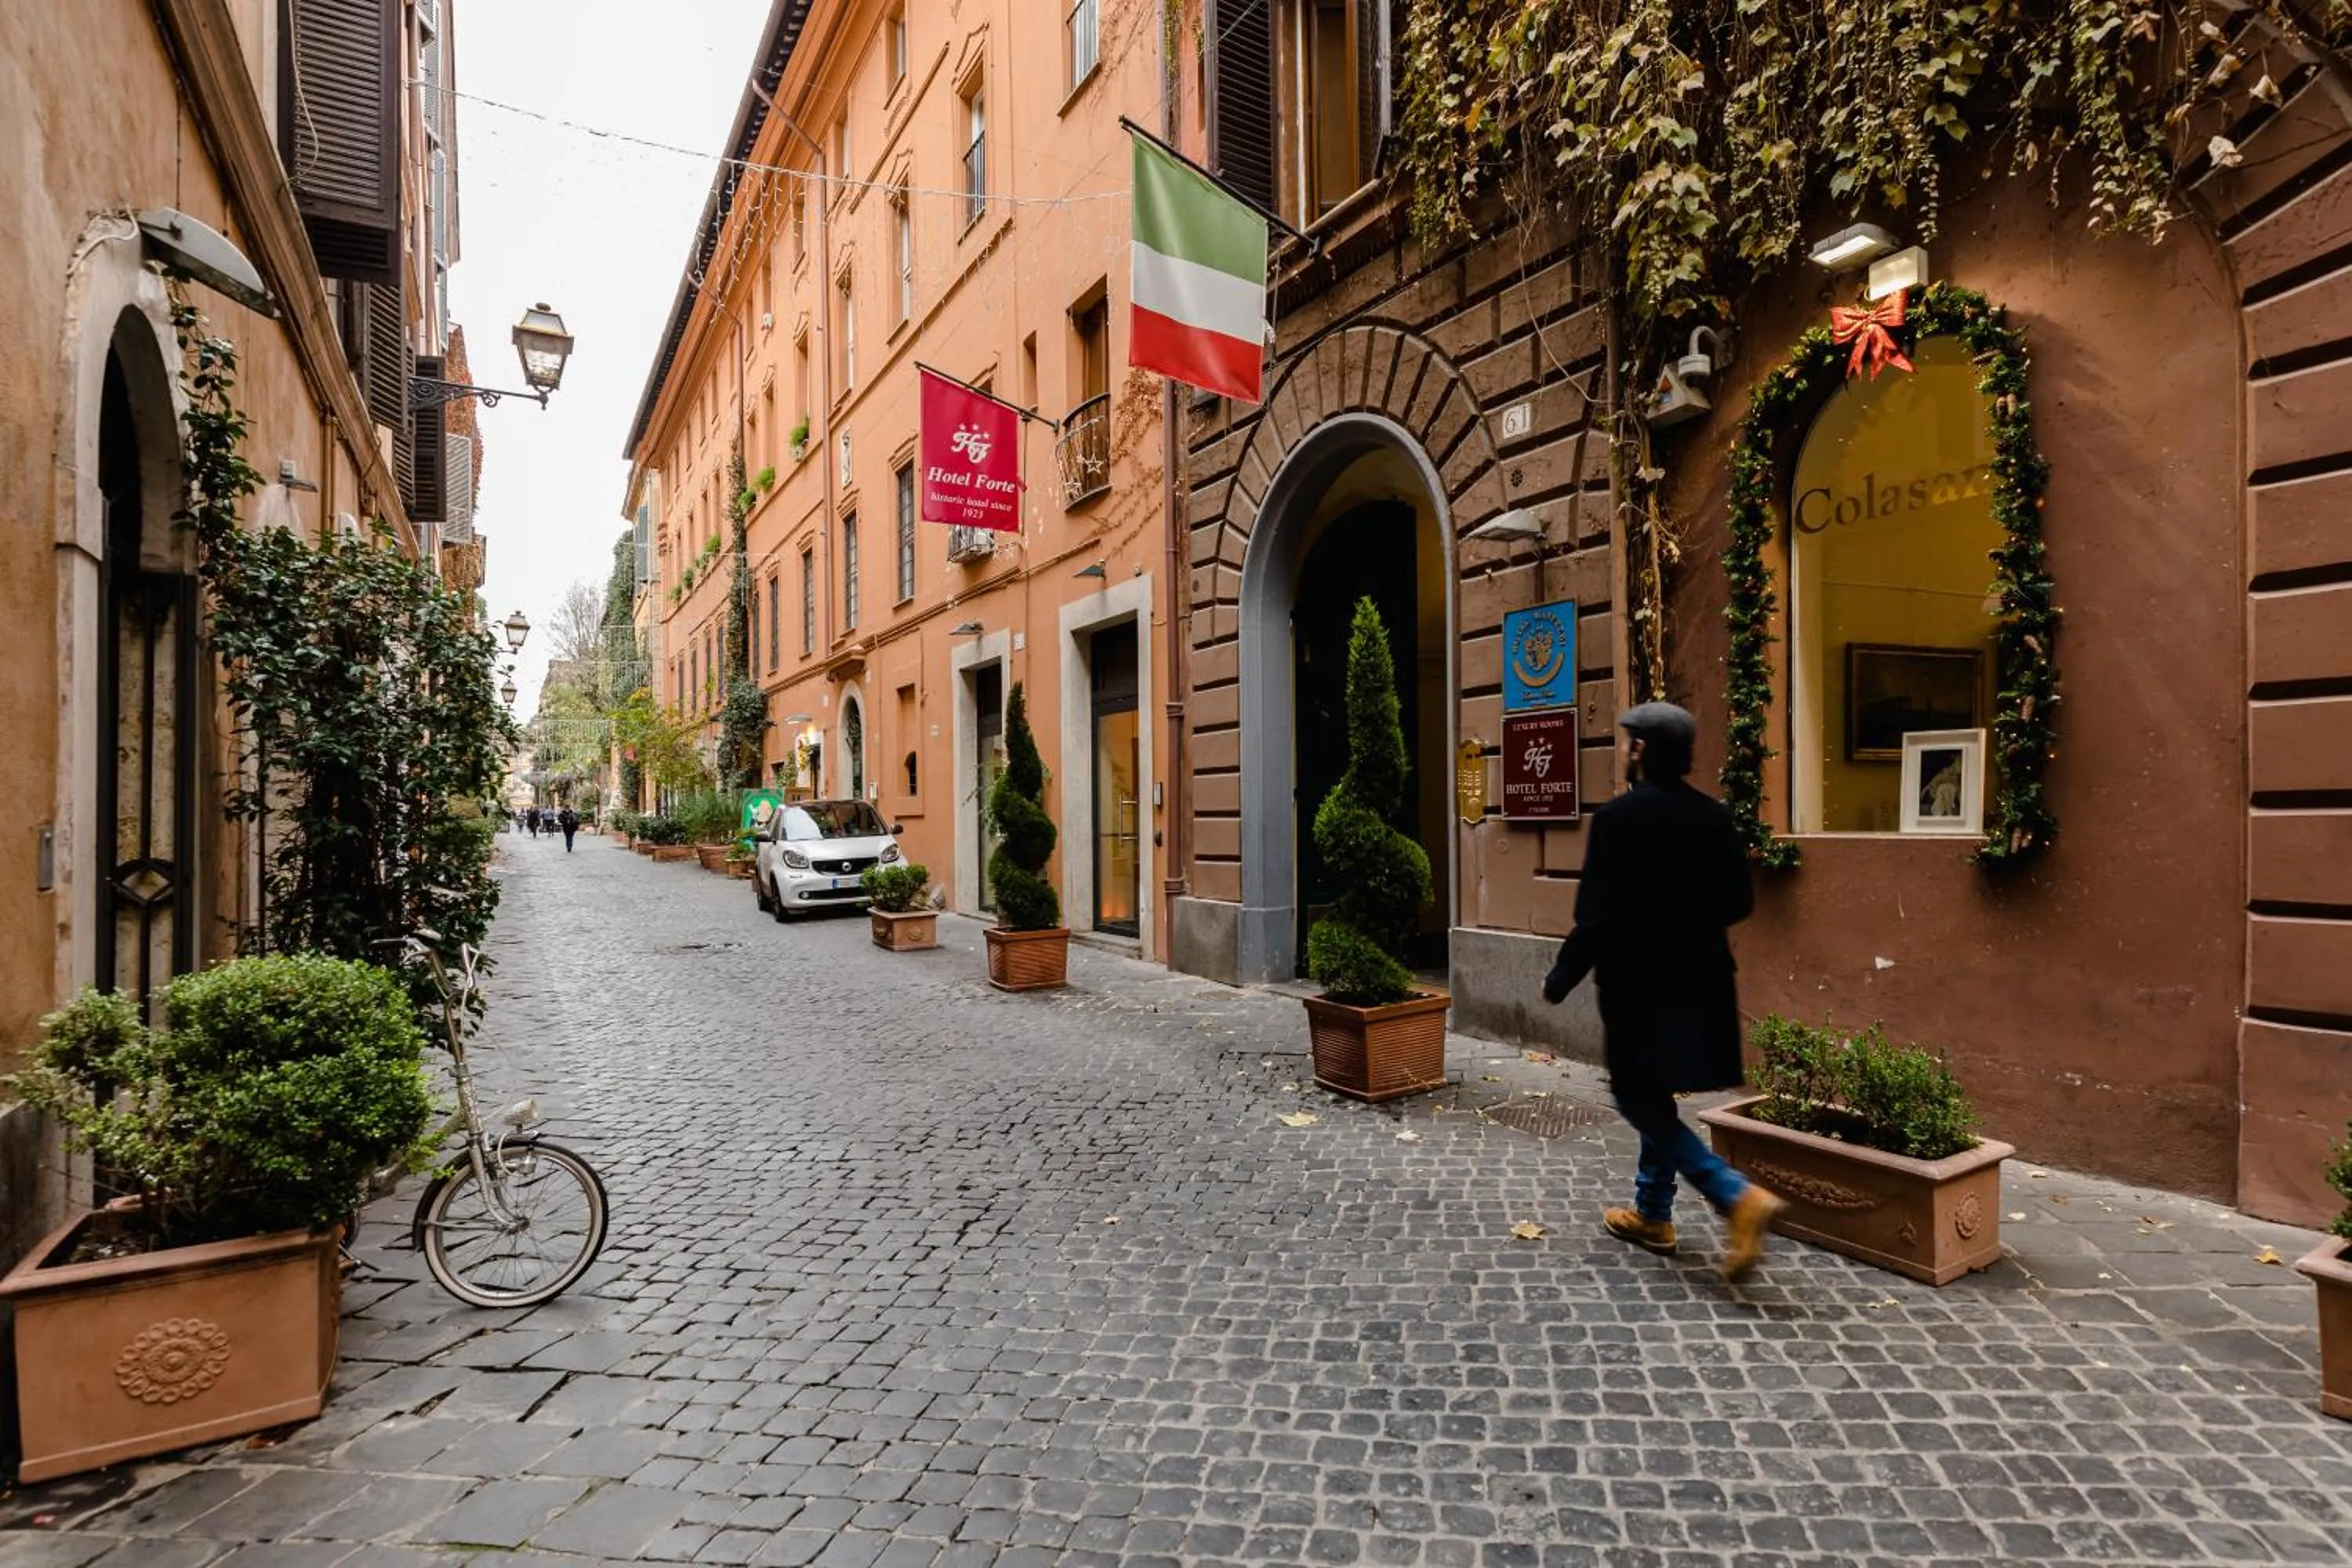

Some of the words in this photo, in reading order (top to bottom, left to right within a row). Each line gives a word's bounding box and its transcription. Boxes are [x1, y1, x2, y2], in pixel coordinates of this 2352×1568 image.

[1504, 405, 1526, 434] 61
[927, 466, 971, 487] Hotel
[975, 474, 1015, 493] Forte
[931, 491, 965, 505] historic
[967, 497, 989, 508] hotel
[990, 501, 1013, 513] since
[1795, 463, 1992, 535] Colasan
[1506, 783, 1537, 795] HOTEL
[1541, 782, 1574, 793] FORTE
